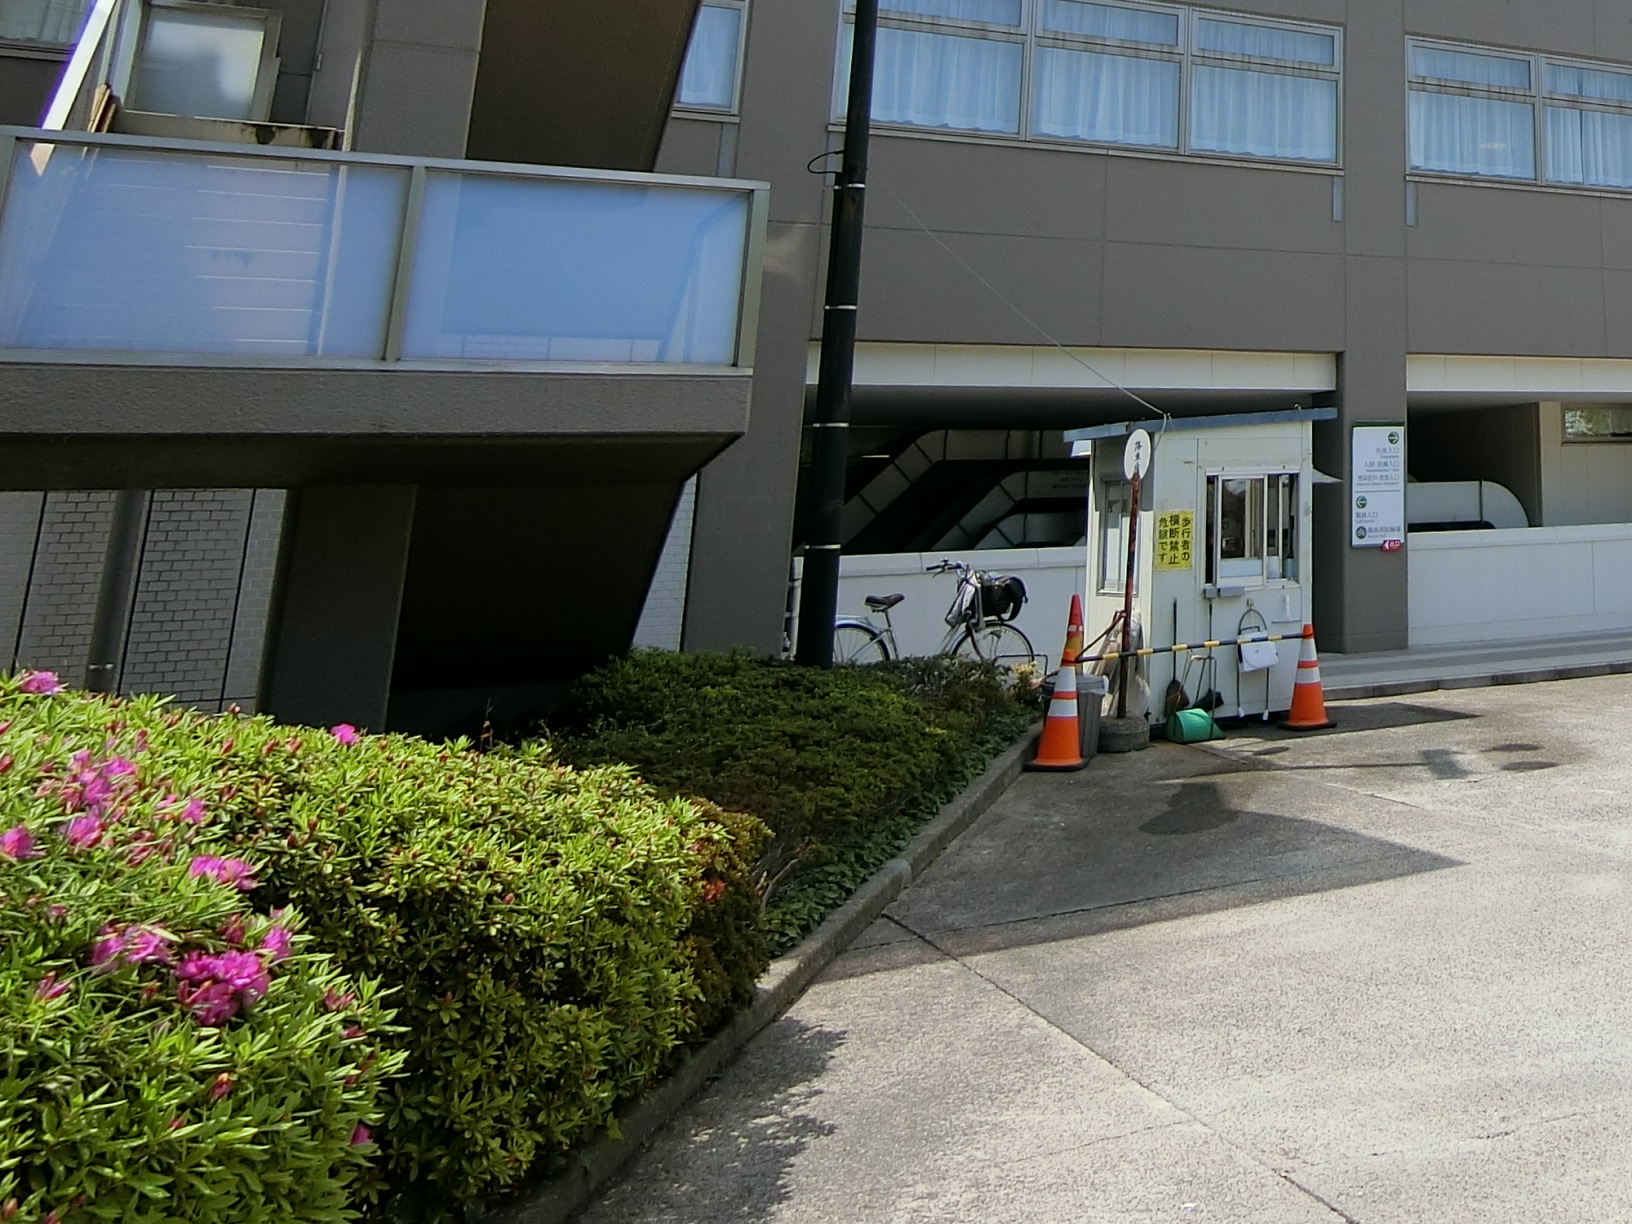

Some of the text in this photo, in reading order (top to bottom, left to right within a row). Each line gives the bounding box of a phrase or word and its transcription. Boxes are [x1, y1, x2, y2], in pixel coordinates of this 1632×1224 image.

[1158, 517, 1169, 563] 危険です
[1168, 514, 1180, 565] 横断禁止
[1181, 516, 1191, 561] 歩行者の
